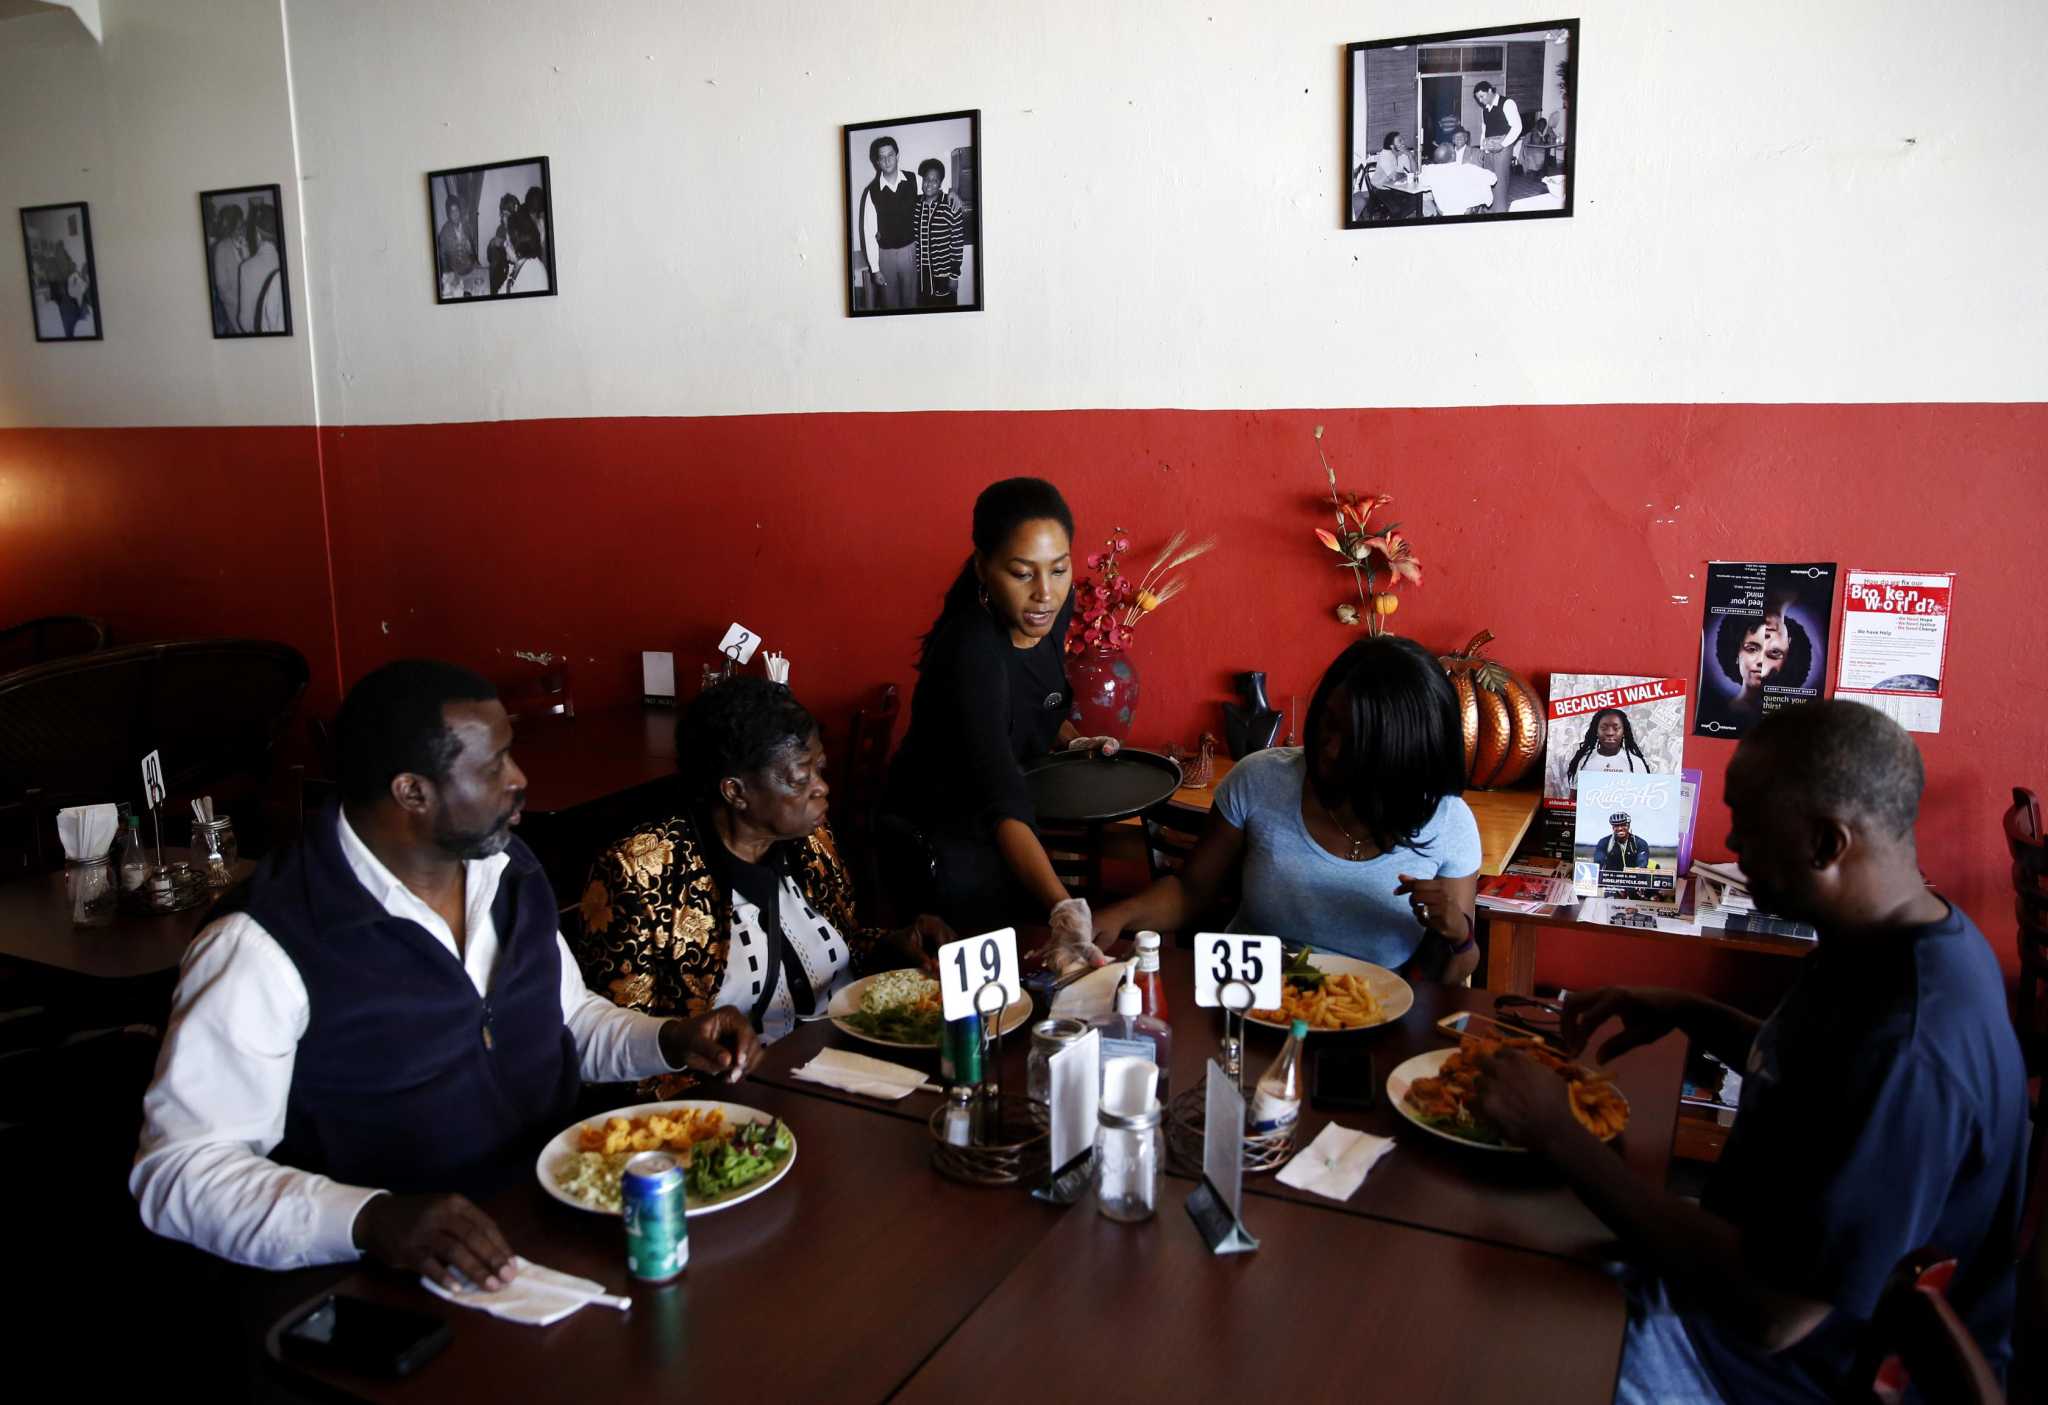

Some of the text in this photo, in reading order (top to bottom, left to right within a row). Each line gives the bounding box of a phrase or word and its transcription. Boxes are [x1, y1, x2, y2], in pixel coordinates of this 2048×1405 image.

[736, 632, 749, 651] 2
[1555, 682, 1679, 715] BECAUSE I WALK...
[954, 938, 1001, 992] 19
[1212, 939, 1263, 984] 35
